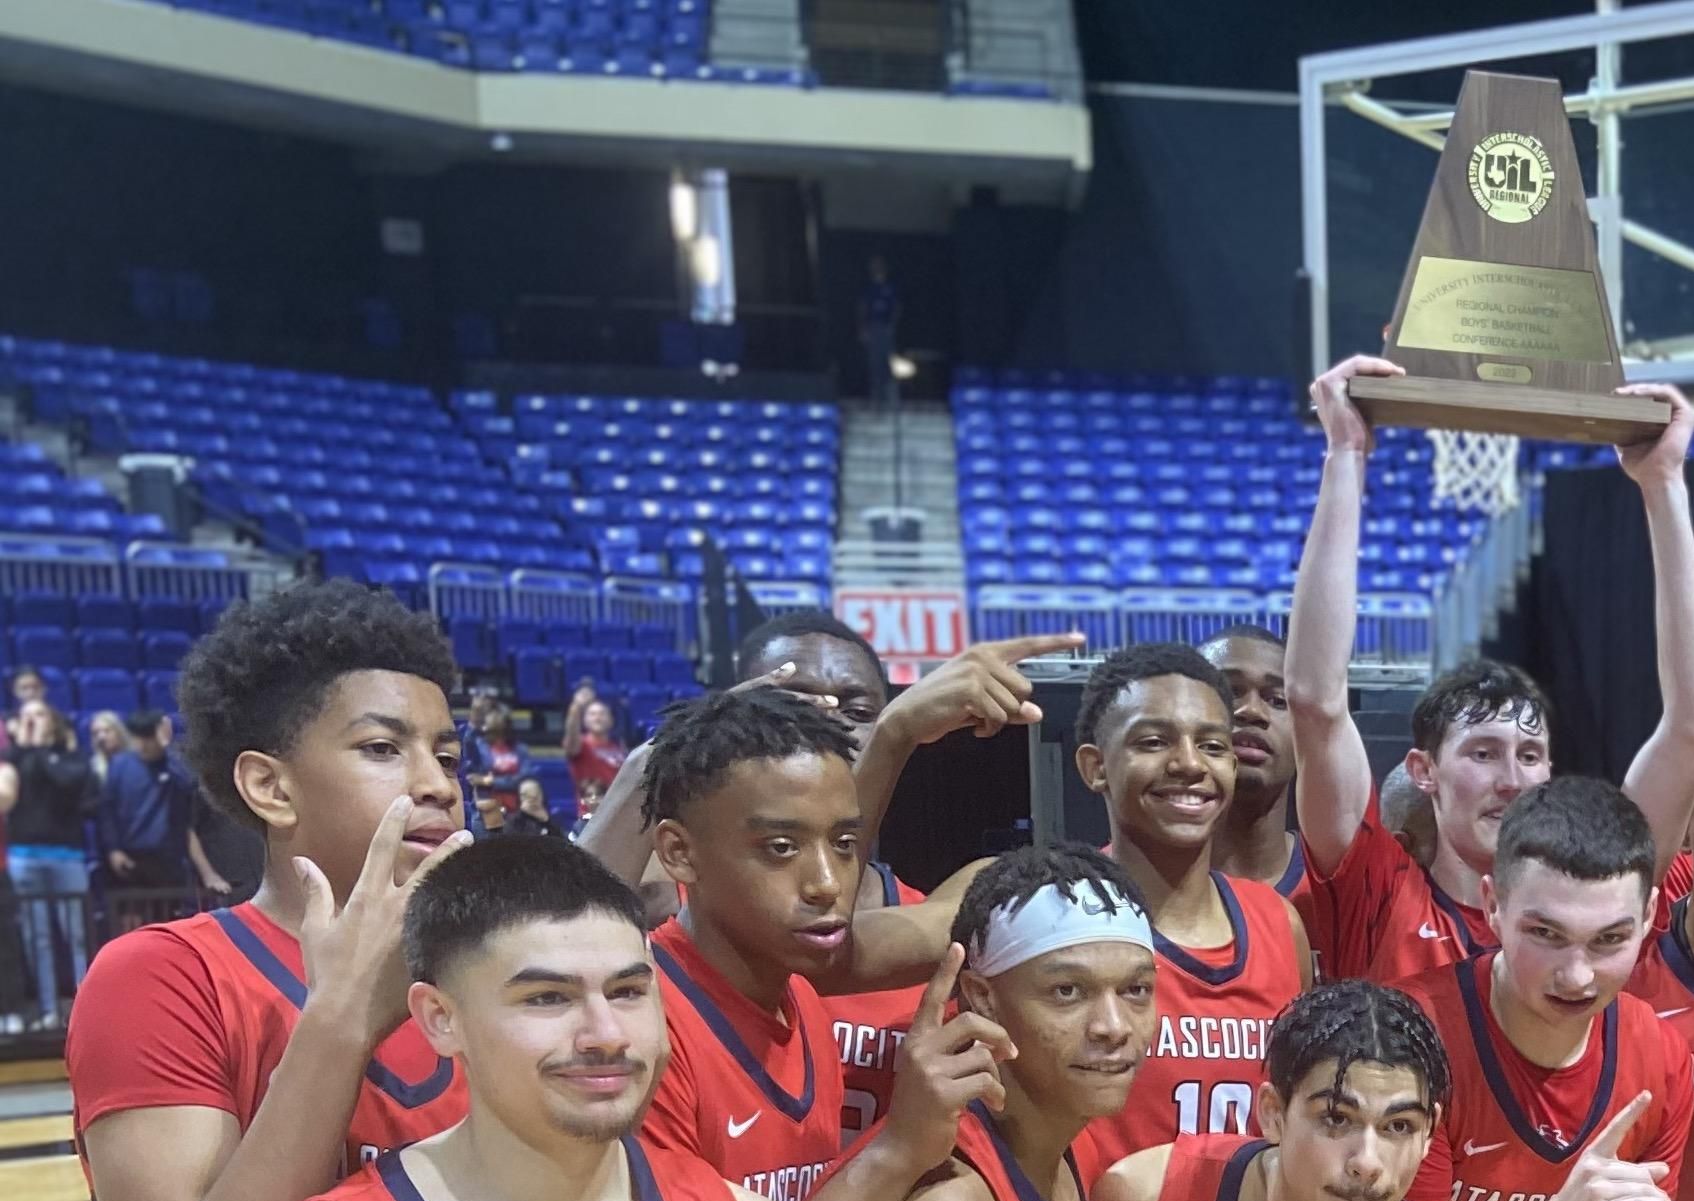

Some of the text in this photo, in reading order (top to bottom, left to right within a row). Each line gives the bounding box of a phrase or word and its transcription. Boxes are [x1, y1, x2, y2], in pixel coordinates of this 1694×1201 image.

[1489, 189, 1529, 205] REGIONAL
[1455, 299, 1504, 314] REGIONAL
[845, 600, 958, 653] EXIT
